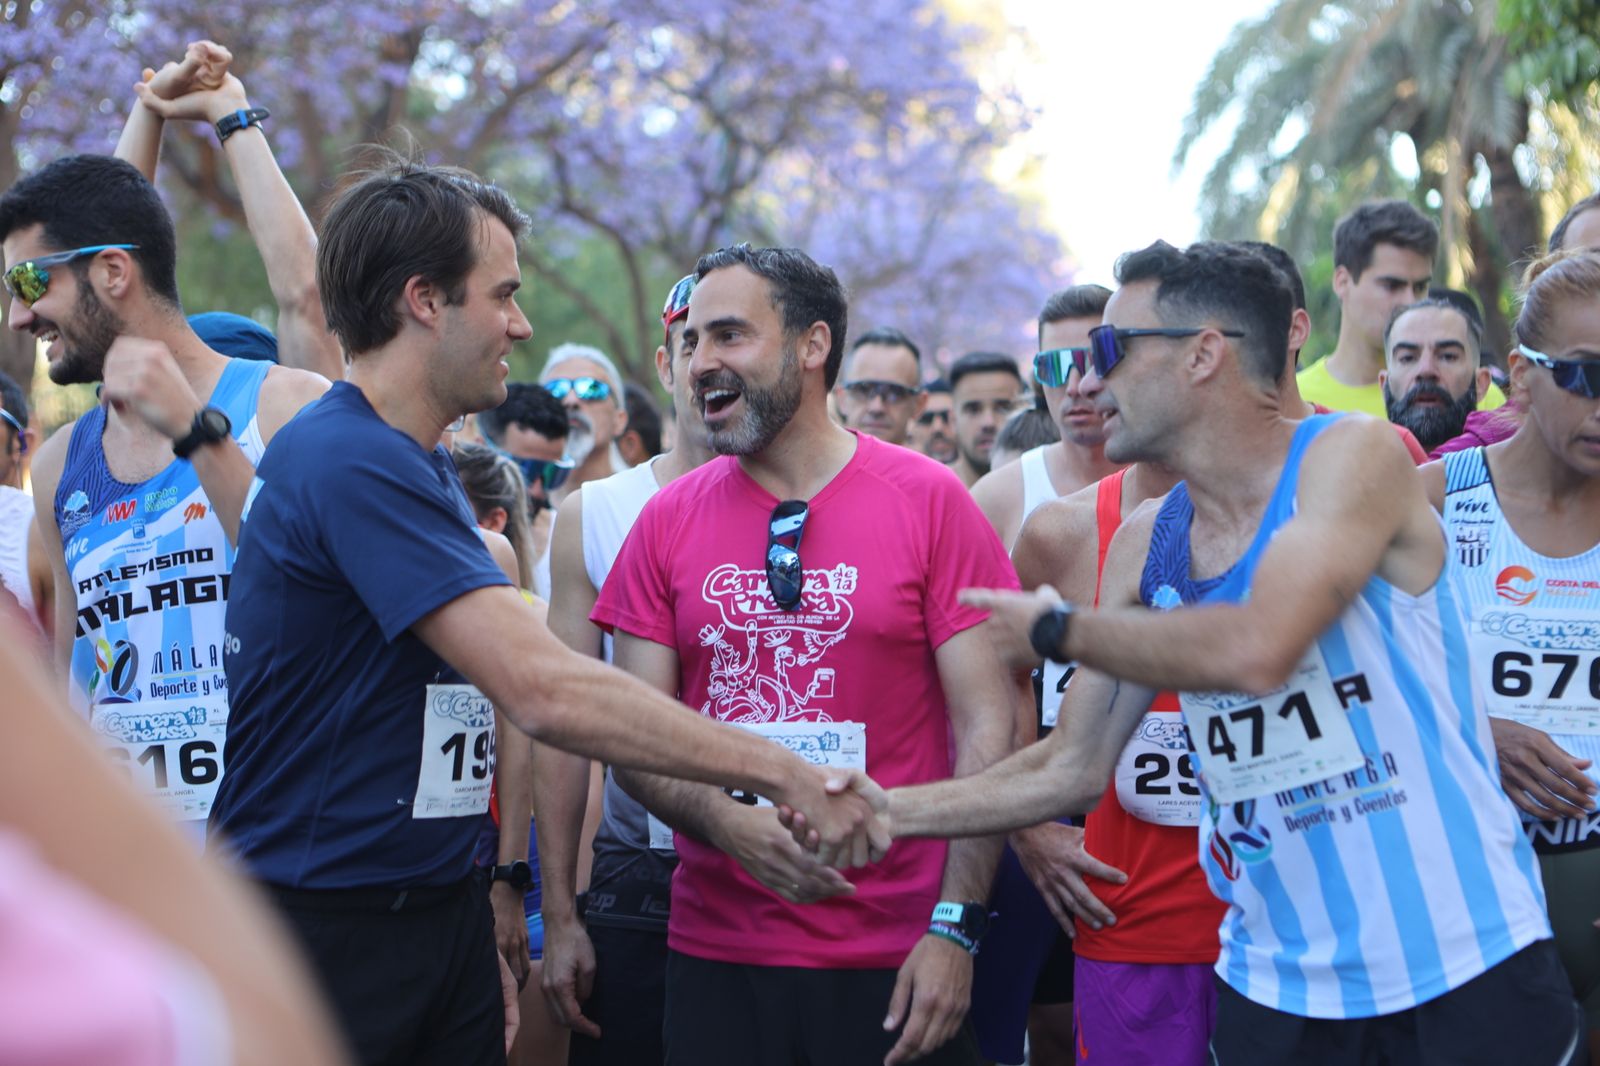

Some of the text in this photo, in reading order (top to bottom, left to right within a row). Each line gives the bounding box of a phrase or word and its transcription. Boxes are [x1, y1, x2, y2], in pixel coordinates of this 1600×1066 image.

[78, 547, 214, 594] ATLETISMO
[713, 568, 830, 594] Carrra
[1546, 579, 1578, 587] COSTA
[731, 592, 837, 616] Presa
[1491, 651, 1600, 701] 67
[150, 678, 198, 701] Deporte
[203, 681, 210, 695] y
[107, 711, 187, 732] Carrera
[1208, 691, 1323, 763] 471
[108, 740, 219, 788] 16
[1284, 808, 1336, 832] Deporte
[1342, 806, 1353, 822] y
